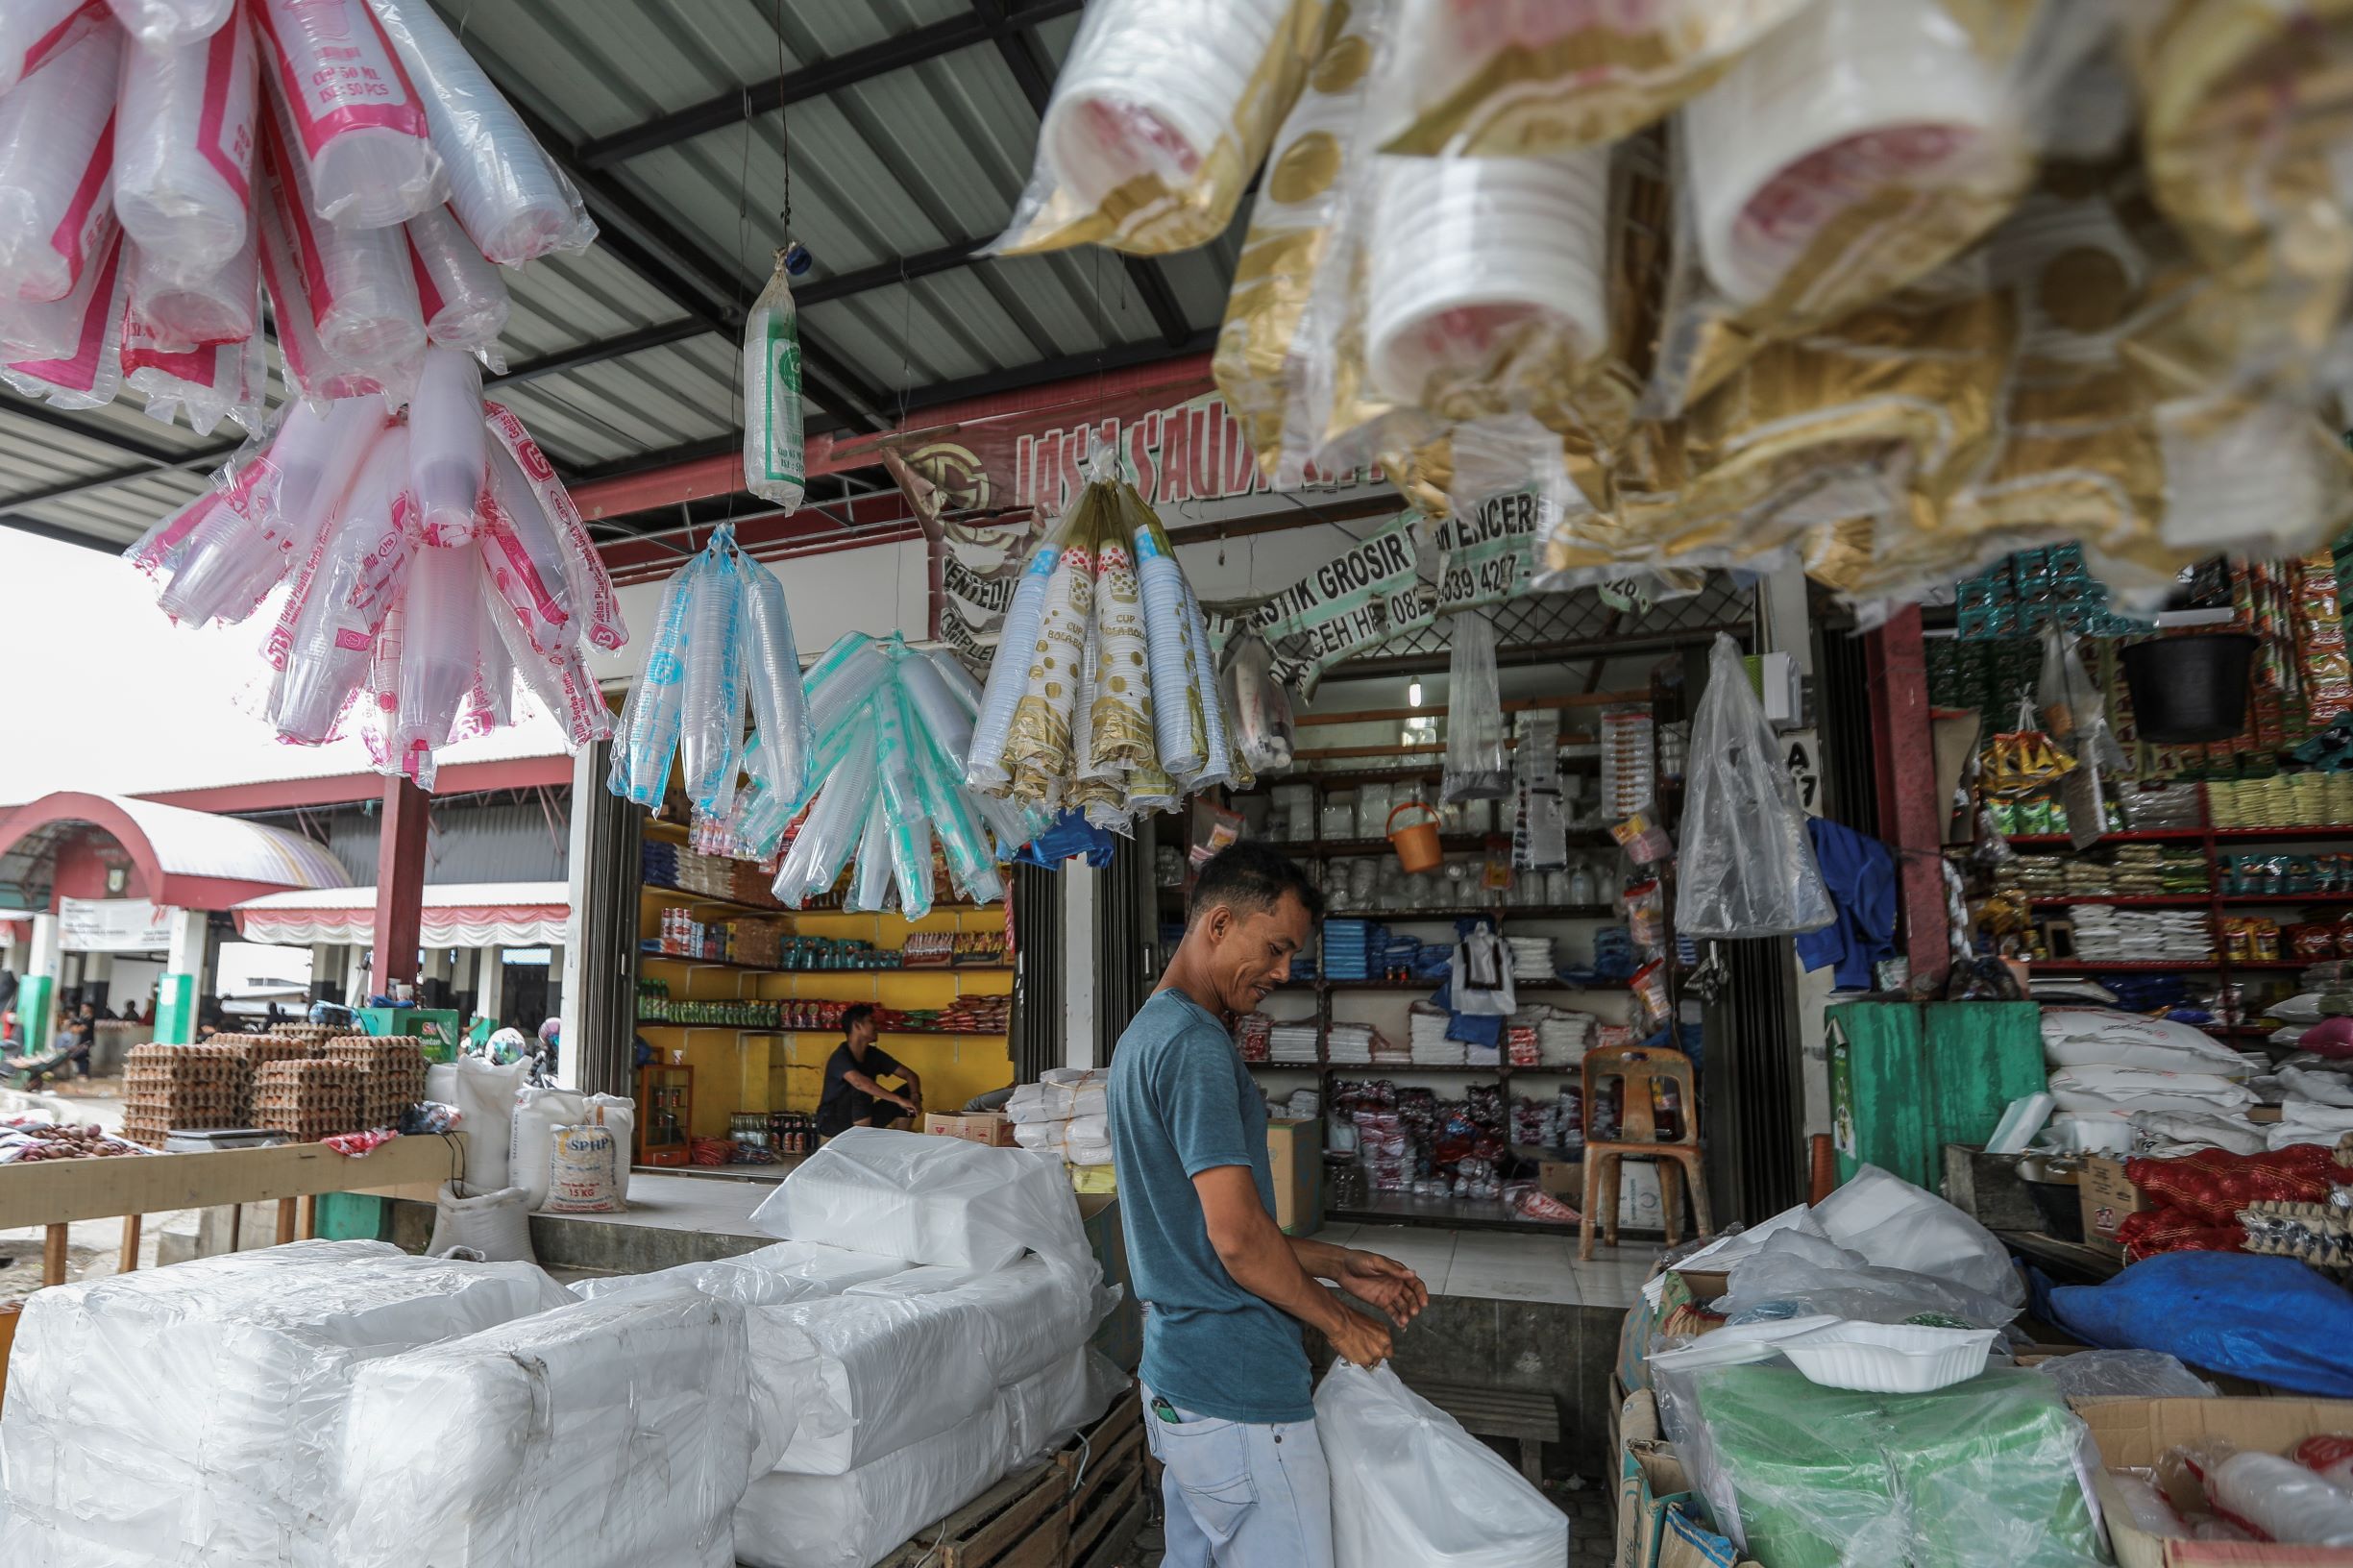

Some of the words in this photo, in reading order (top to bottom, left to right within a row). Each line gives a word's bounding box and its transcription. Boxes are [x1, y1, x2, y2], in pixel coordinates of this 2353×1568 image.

[341, 66, 357, 80] 50
[361, 66, 381, 81] ML
[348, 83, 362, 96] 50
[366, 84, 389, 96] PCS
[1316, 533, 1411, 600] GROSIR
[1456, 493, 1539, 548] ENCER
[1115, 614, 1136, 625] CUP
[1066, 621, 1084, 636] CUP
[1788, 741, 1810, 771] A
[571, 1138, 610, 1152] SPHP
[569, 1188, 578, 1197] 15
[580, 1188, 595, 1197] KG
